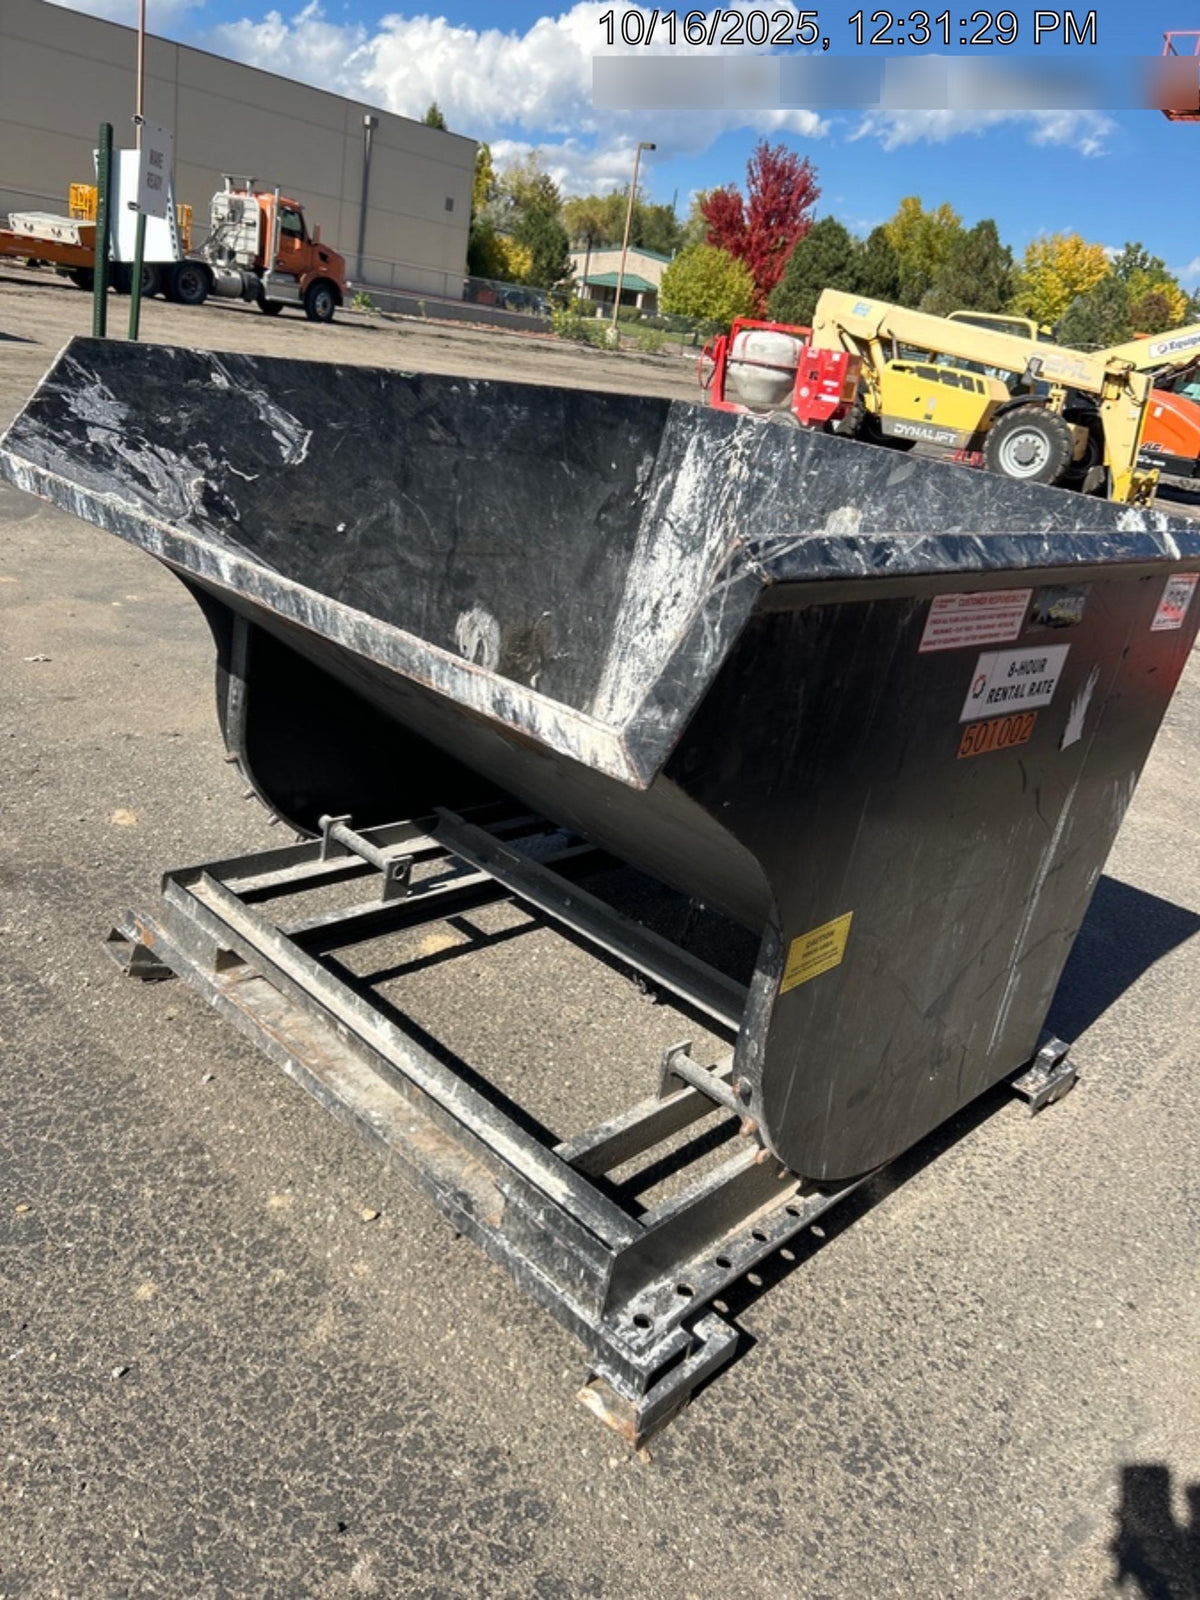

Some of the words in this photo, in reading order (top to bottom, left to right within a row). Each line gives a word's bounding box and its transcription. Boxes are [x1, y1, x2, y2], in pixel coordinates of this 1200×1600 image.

[1169, 334, 1200, 350] Equip
[893, 422, 958, 444] DYNALIFT
[1007, 657, 1048, 678] 8-HOUR
[985, 683, 1026, 704] RENTAL
[1026, 678, 1056, 698] RATE
[960, 711, 1036, 755] 501002
